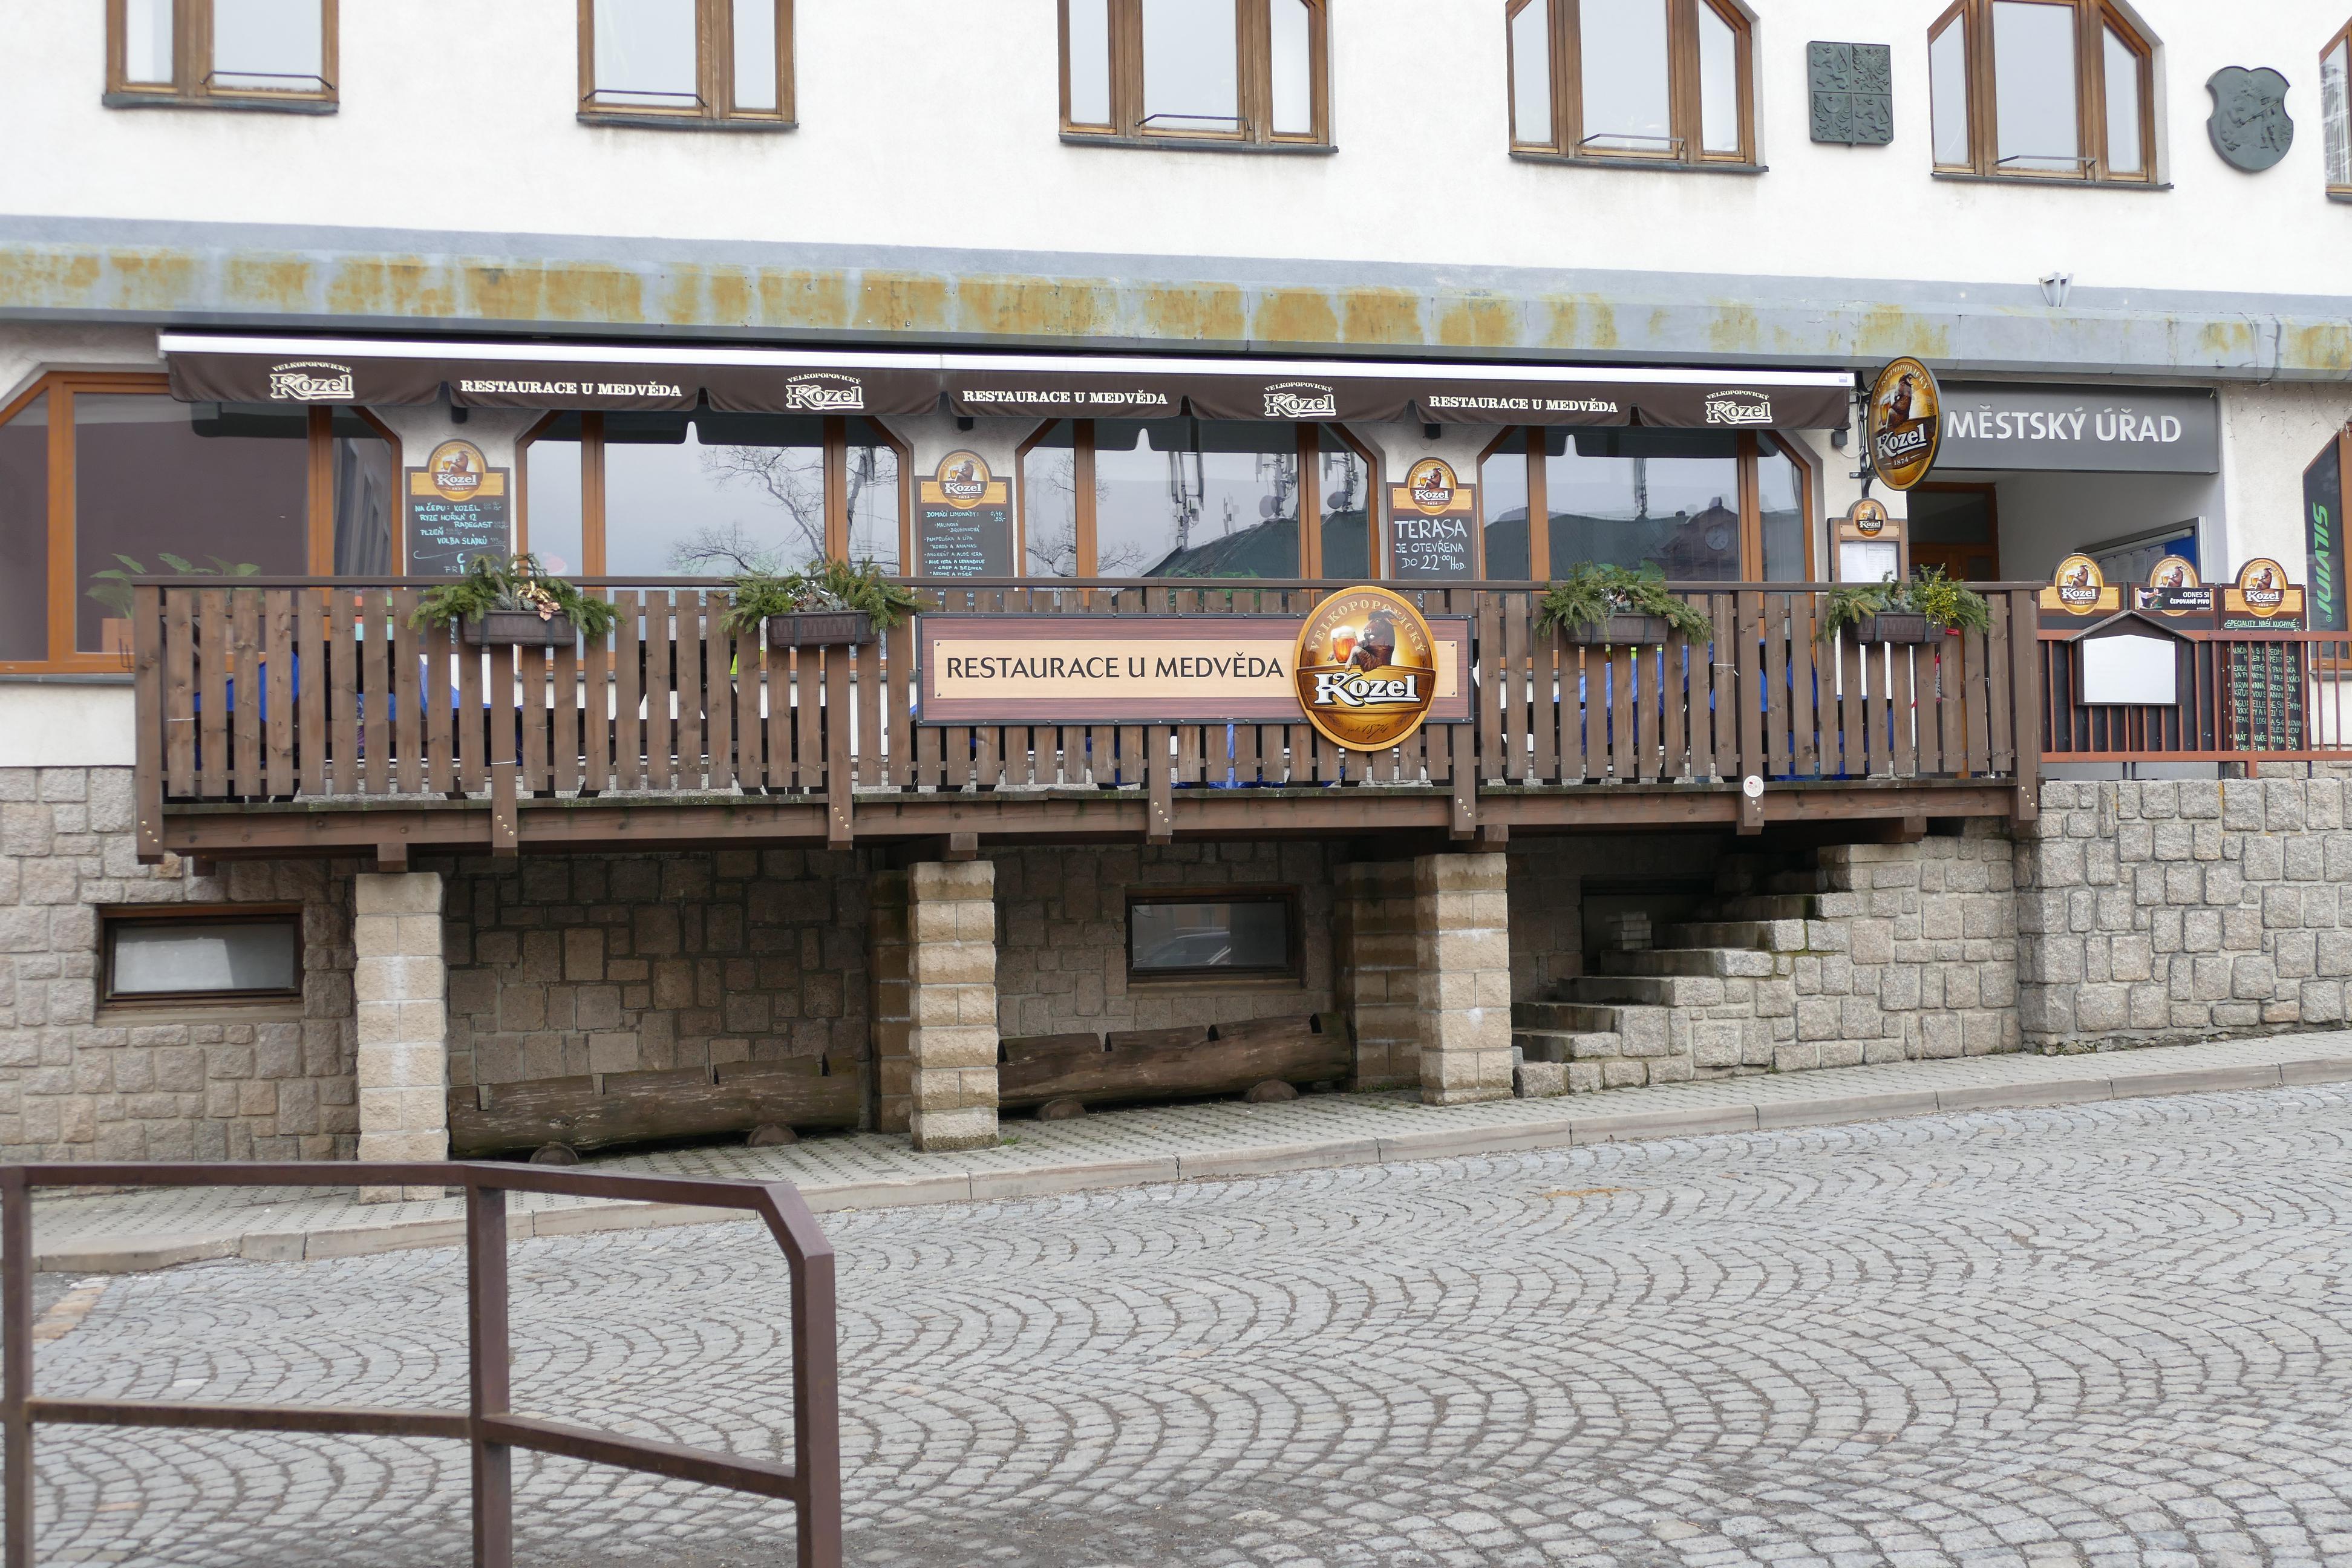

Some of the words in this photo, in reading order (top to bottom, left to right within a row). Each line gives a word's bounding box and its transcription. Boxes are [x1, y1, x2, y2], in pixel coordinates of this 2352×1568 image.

[272, 361, 352, 373] VELKOPOPOVICKÝ
[787, 373, 861, 384] VELKOPOPOVICKÝ
[270, 373, 354, 400] Kozel
[460, 380, 577, 394] RESTAURACE
[581, 383, 593, 394] U
[597, 381, 682, 397] MEDVĚDA
[1264, 382, 1333, 392] VELKOPOPOVICKÝ
[786, 385, 864, 410] Kozel
[962, 390, 1070, 403] RESTAURACE
[1074, 392, 1085, 403] U
[1089, 389, 1168, 405] MEDVĚDA
[1706, 390, 1769, 400] VELKOPOPOVICKÝ
[1264, 393, 1336, 417] Kozel
[1429, 396, 1529, 410] RESTAURACE
[1532, 399, 1543, 410] U
[1546, 397, 1618, 413] MEDVĚDA
[1705, 400, 1772, 424] Kozel
[1947, 403, 2086, 440] MĚSTSKÝ
[2095, 407, 2182, 442] ÚŘAD
[1875, 423, 1927, 460] Kozel
[1893, 457, 1909, 465] 1874
[437, 474, 477, 486] Kozel
[945, 483, 982, 494] Kozel
[1414, 489, 1449, 500] Kozel
[426, 502, 449, 512] ČEPU:
[420, 526, 443, 535] PLZEŇ
[1394, 518, 1468, 539] TERASA
[1396, 543, 1407, 553] JE
[1411, 539, 1464, 553] OTEVŘENA
[1402, 558, 1418, 568] DO
[2313, 502, 2332, 614] SILVINI
[2062, 588, 2096, 599] Kozel
[2246, 590, 2280, 603] Kozel
[1310, 599, 1426, 652] VELKOPOPOVICKÝ
[947, 657, 1119, 678] RESTAURACE
[1128, 658, 1145, 678] U
[1155, 652, 1284, 678] MEDVĚDA
[1314, 672, 1420, 707] Kozel
